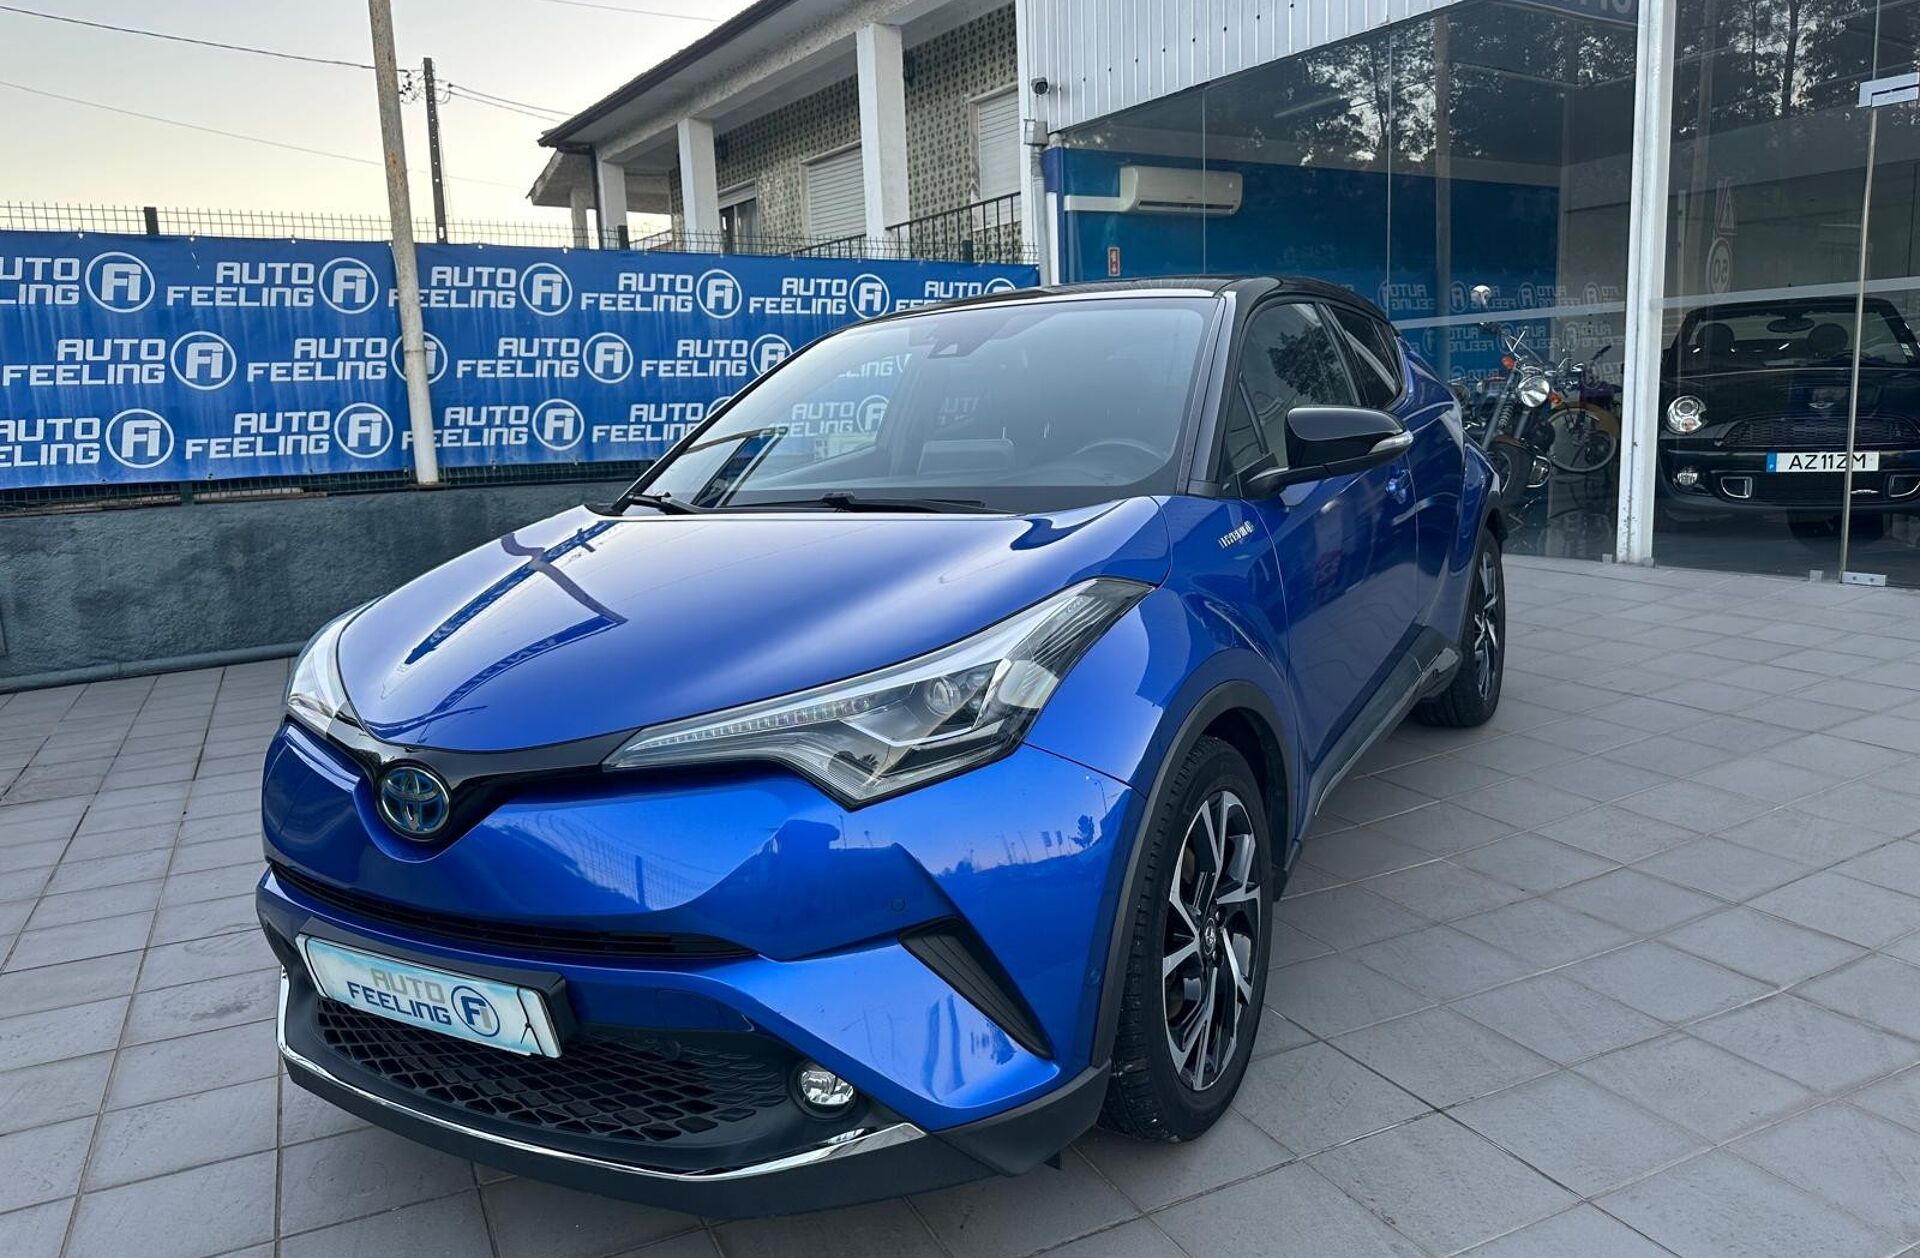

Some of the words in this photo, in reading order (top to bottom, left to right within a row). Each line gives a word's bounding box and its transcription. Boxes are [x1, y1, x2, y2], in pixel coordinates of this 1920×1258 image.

[0, 257, 80, 281] UTO
[216, 262, 314, 284] AUTO
[431, 266, 516, 288] AUTO
[618, 272, 693, 293] AUTO
[781, 278, 847, 297] AUTO
[925, 281, 982, 298] AUTO
[167, 286, 314, 307] FEELING
[580, 292, 693, 312] FEELING
[749, 297, 846, 314] FEELING
[57, 339, 166, 361] AUTO
[293, 338, 388, 359] AUTO
[498, 337, 580, 358] AUTO
[677, 339, 748, 358] AUTO
[2, 363, 165, 386] FEELING
[246, 360, 387, 382] FEELING
[456, 359, 580, 379] FEELING
[641, 359, 747, 378] FEELING
[444, 405, 529, 427] AUTO
[629, 402, 703, 422] AUTO
[790, 401, 855, 420] AUTO
[234, 410, 330, 434] AUTO
[185, 434, 329, 460] FEELING
[371, 967, 446, 1005] AUTO
[346, 980, 452, 1026] FEELING
